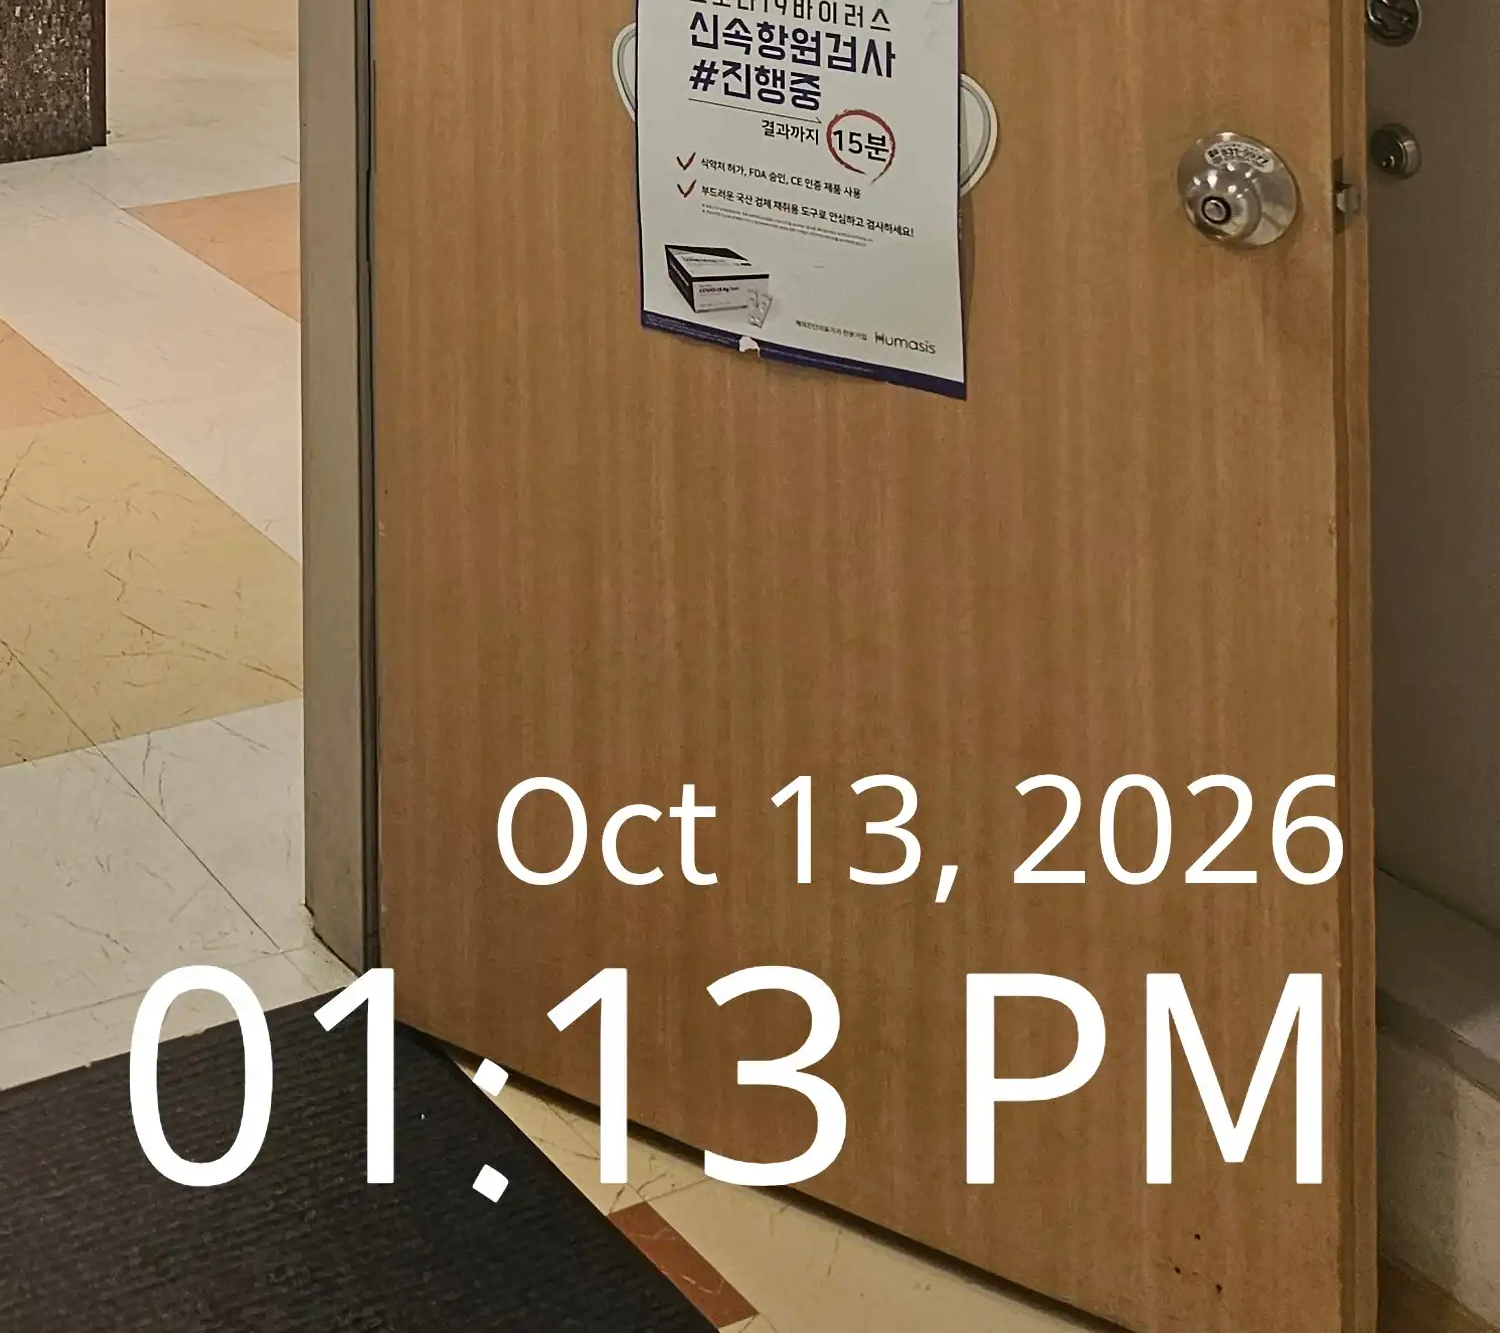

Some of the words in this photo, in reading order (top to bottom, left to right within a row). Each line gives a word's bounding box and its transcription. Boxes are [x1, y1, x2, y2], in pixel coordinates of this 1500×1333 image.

[689, 11, 896, 78] 신속항원검사
[688, 59, 821, 111] #진행중
[762, 119, 819, 145] 결과까지
[833, 129, 890, 162] 15분
[749, 167, 767, 179] FDA
[791, 176, 803, 186] CE
[804, 178, 822, 190] 인증
[843, 187, 861, 199] 사용
[701, 185, 735, 201] 부드러운
[736, 192, 753, 205] 국산
[801, 205, 828, 220] 도구로
[829, 211, 864, 228] 안심하고
[866, 218, 915, 237] 검사하세요!
[875, 331, 937, 354] Humasis
